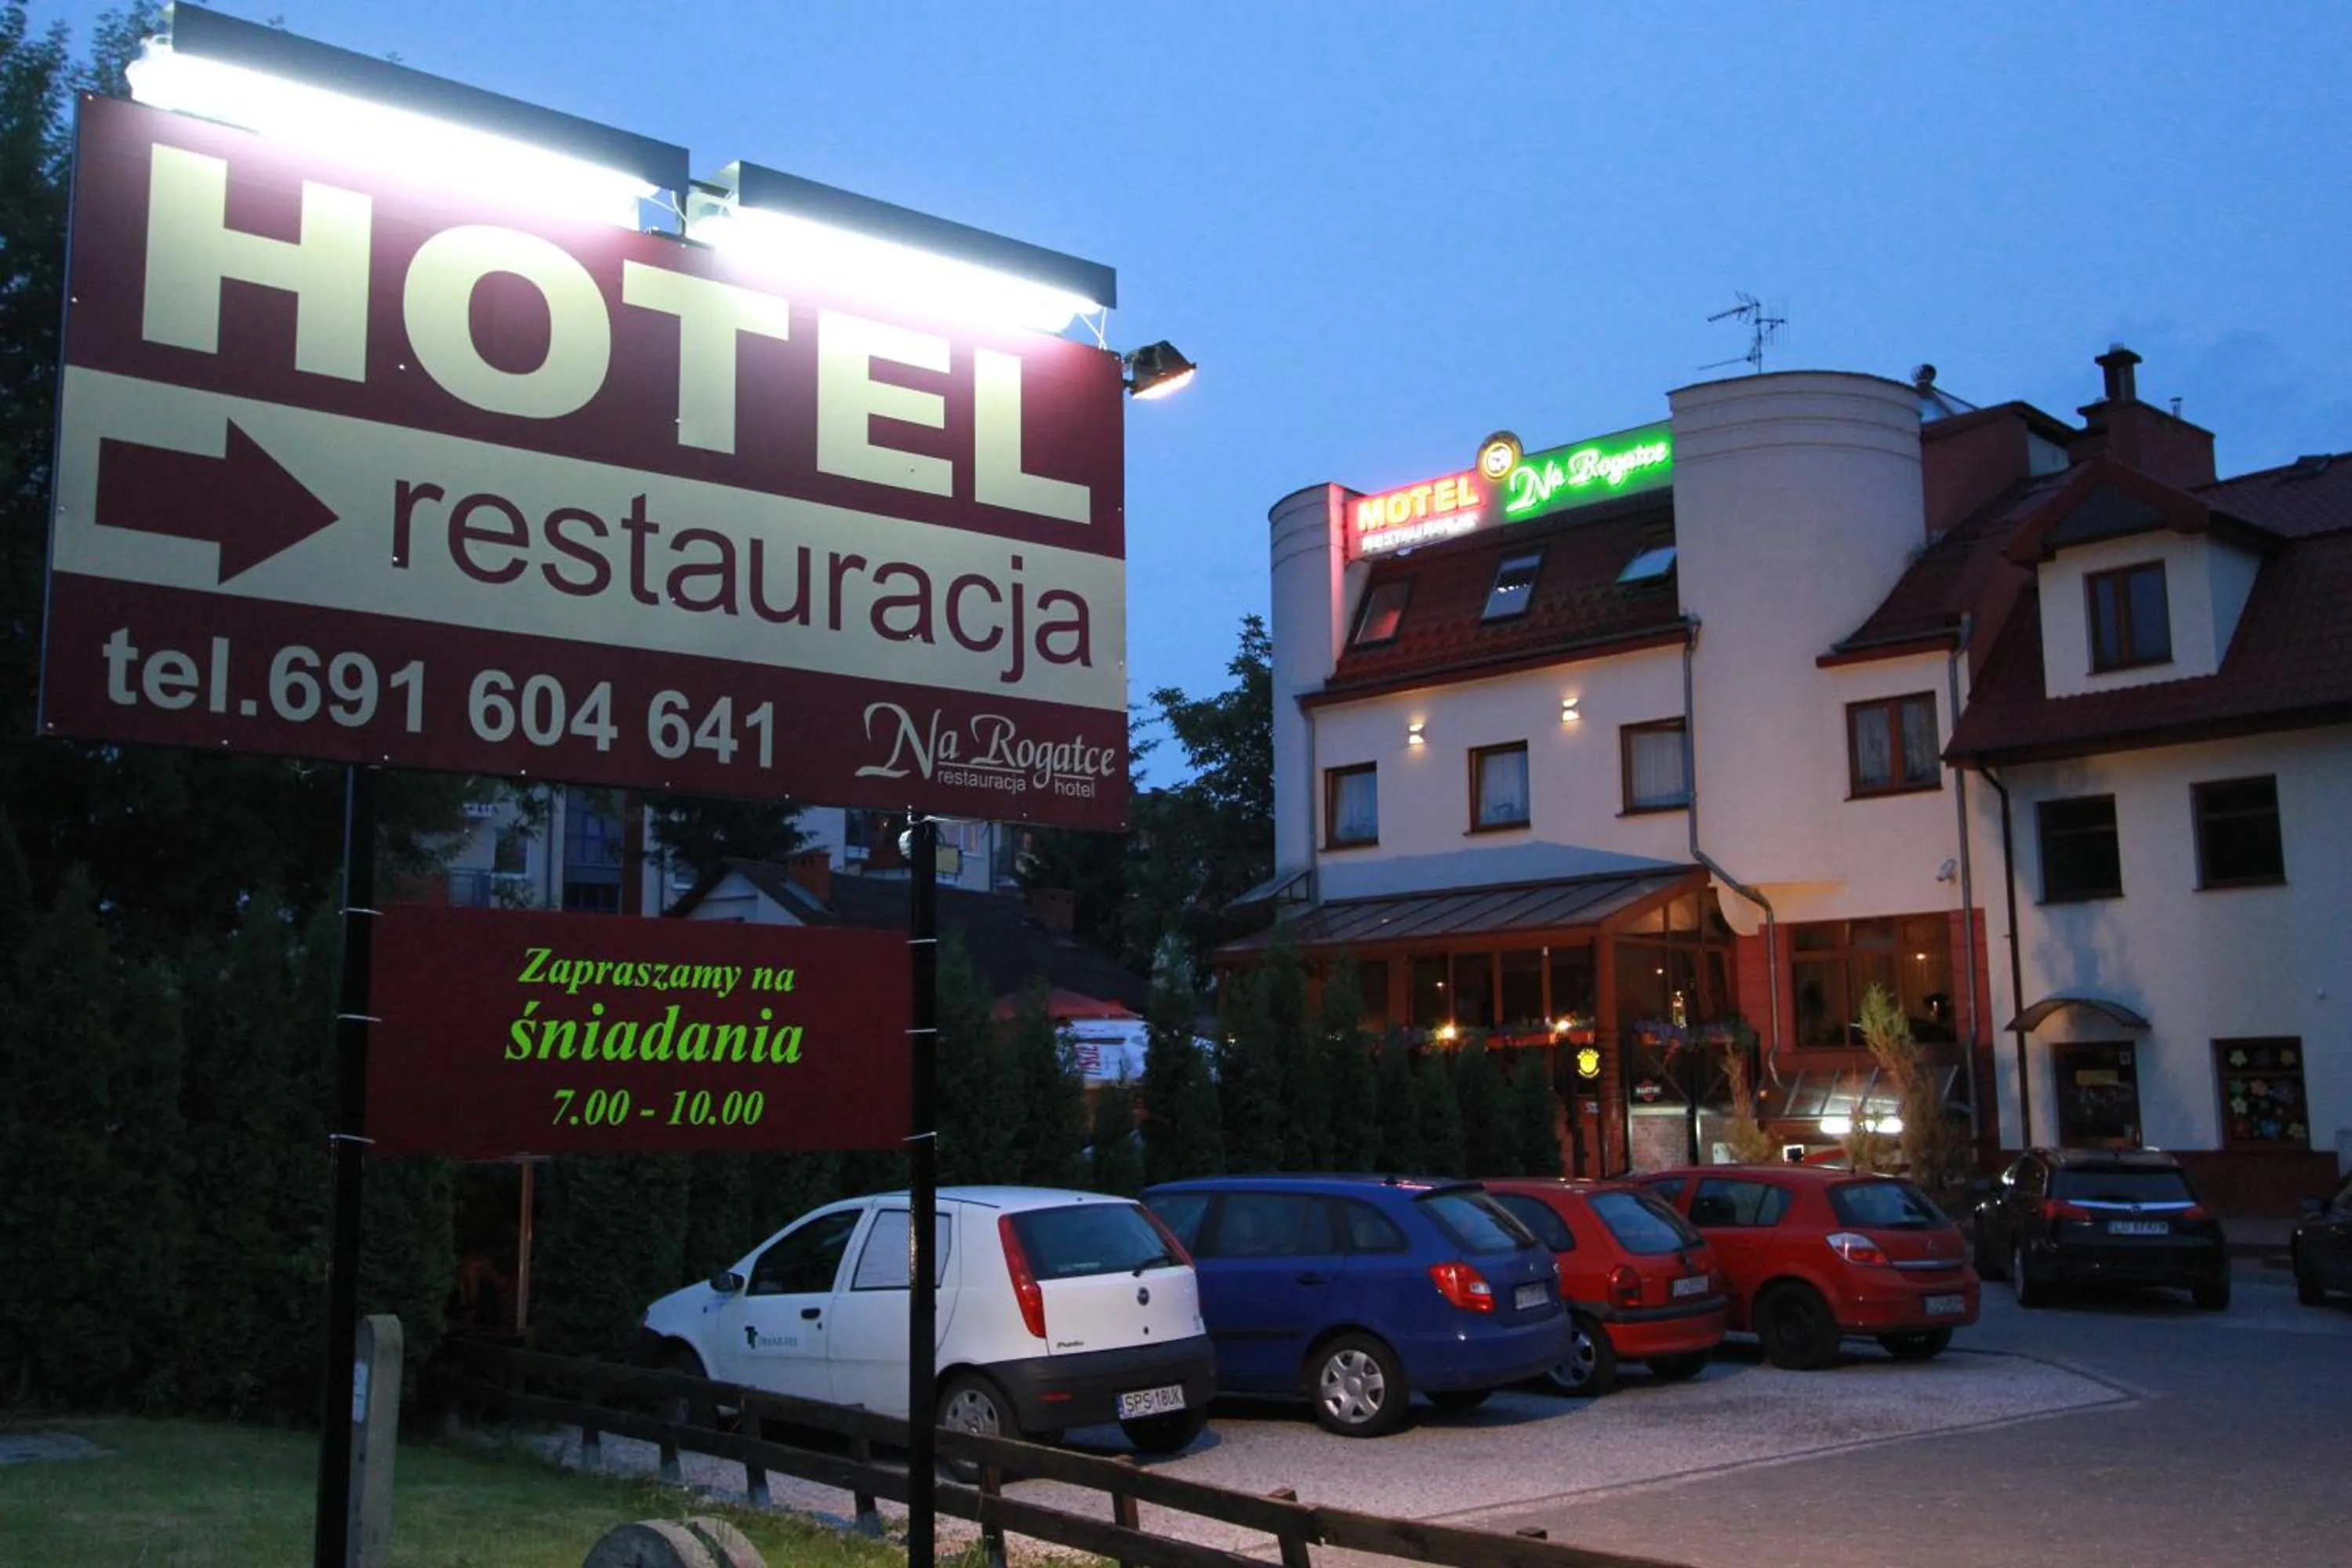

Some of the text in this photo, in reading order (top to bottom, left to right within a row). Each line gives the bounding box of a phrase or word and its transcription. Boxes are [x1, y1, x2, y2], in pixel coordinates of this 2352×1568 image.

[143, 143, 1091, 524] HOTEL
[1357, 477, 1480, 532] MOTEL
[1505, 463, 1564, 512] Na
[394, 477, 1094, 684] restauracja
[469, 669, 618, 752] 604
[648, 690, 774, 769] 641
[855, 702, 1116, 788] Na Rogatce
[938, 769, 1095, 797] restauracja hotel
[517, 948, 795, 998] Zapraszamy na
[504, 1001, 804, 1064] śniadania
[553, 1090, 630, 1126] 7.00
[666, 1091, 764, 1126] 10.00
